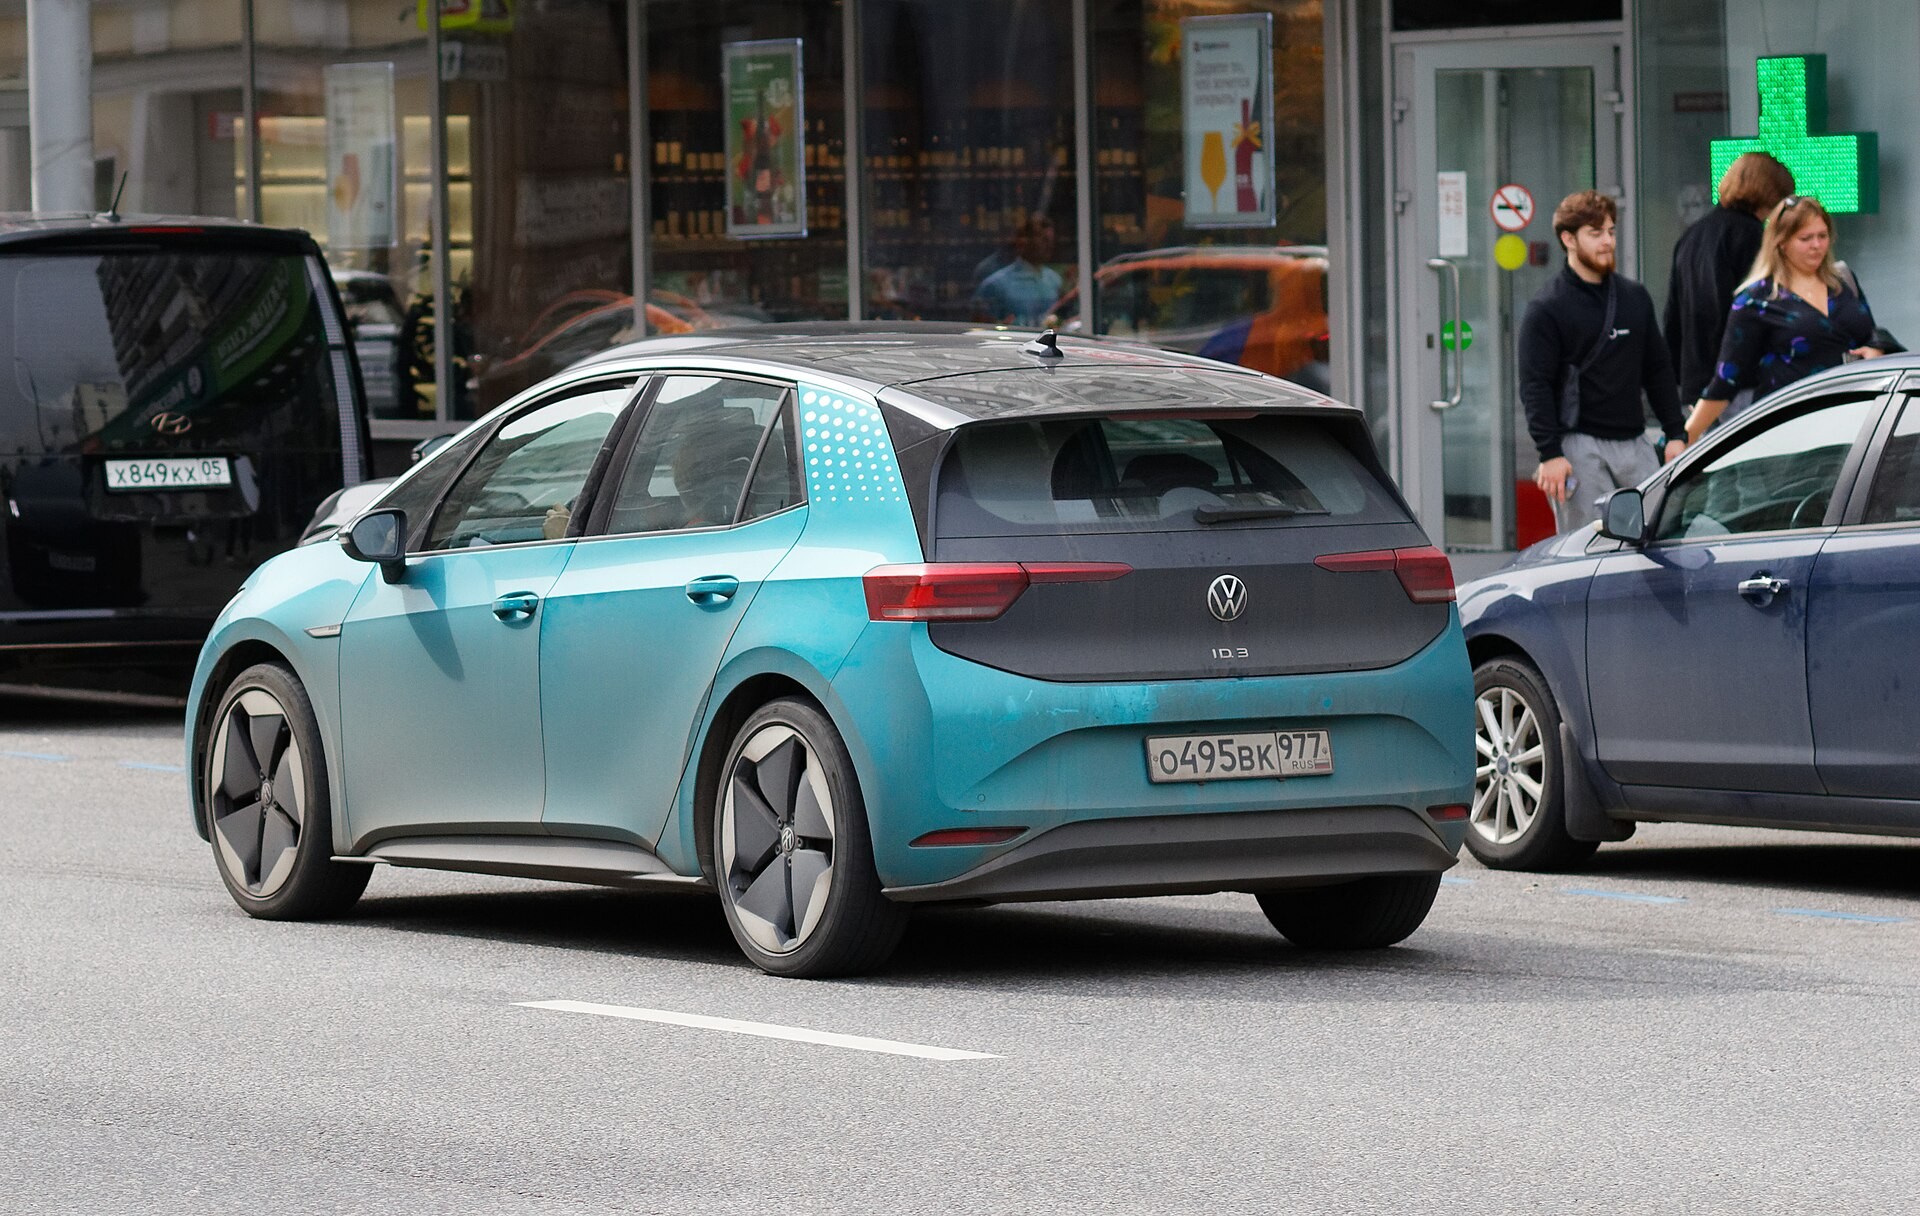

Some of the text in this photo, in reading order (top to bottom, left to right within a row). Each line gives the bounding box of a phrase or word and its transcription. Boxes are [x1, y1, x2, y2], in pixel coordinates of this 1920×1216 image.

[201, 460, 222, 476] 05
[1278, 732, 1321, 760] 977
[1291, 758, 1314, 770] RUS
